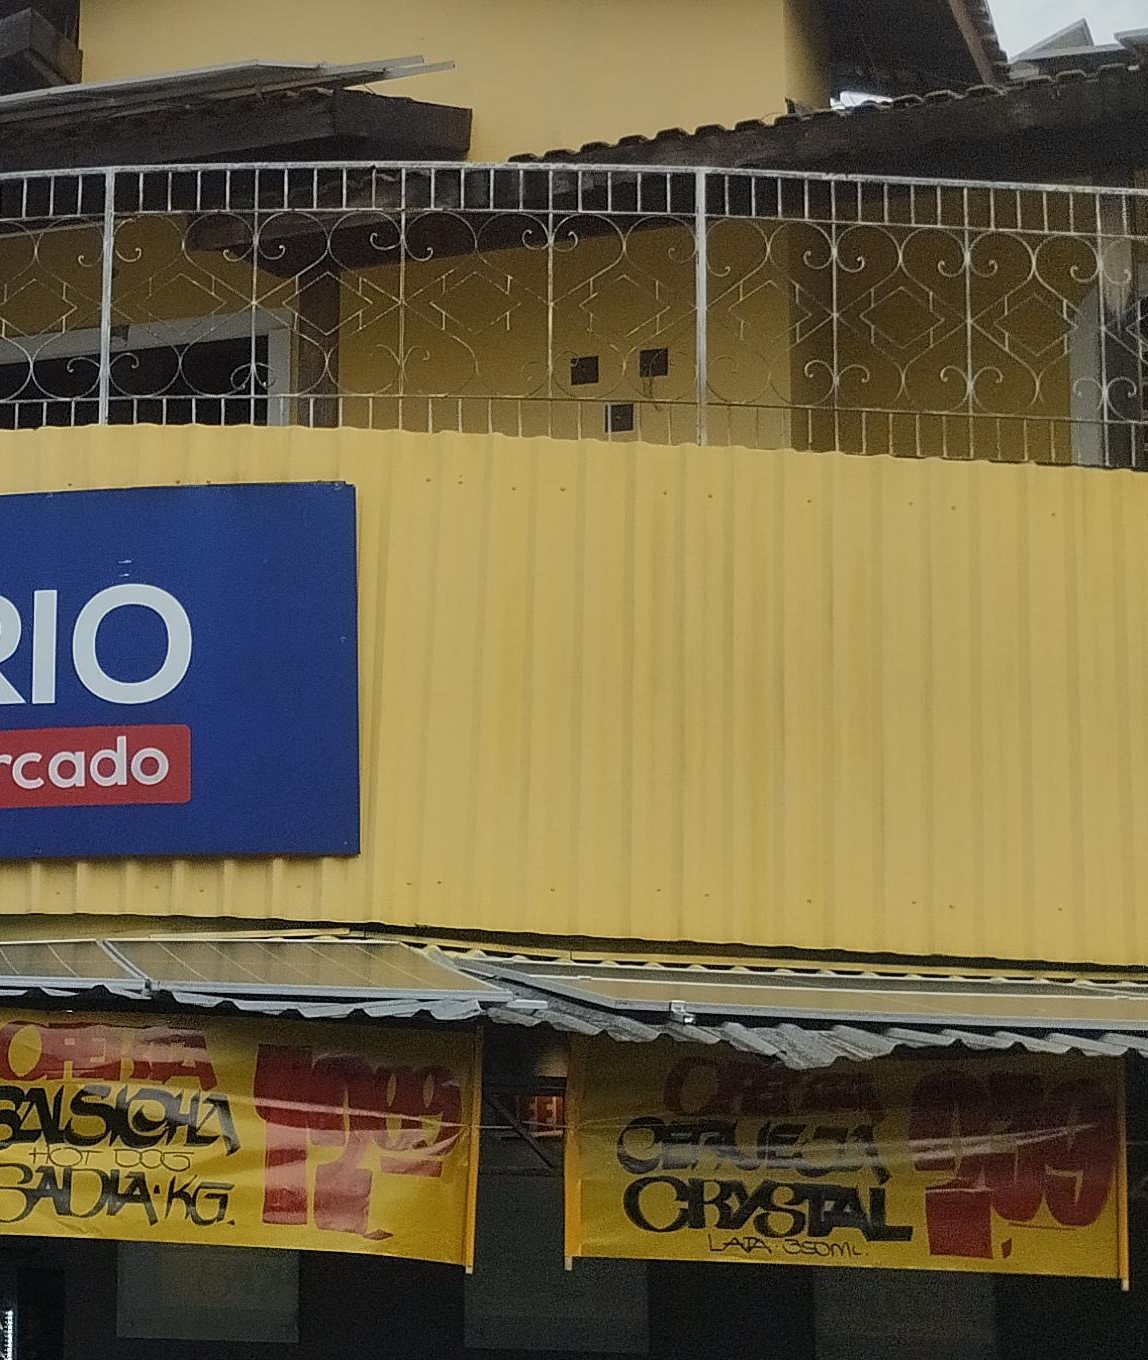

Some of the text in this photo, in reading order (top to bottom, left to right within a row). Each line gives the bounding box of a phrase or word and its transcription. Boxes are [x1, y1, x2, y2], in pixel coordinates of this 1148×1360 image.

[29, 1147, 194, 1172] HOT DOG
[623, 1175, 913, 1241] CRYSTAL
